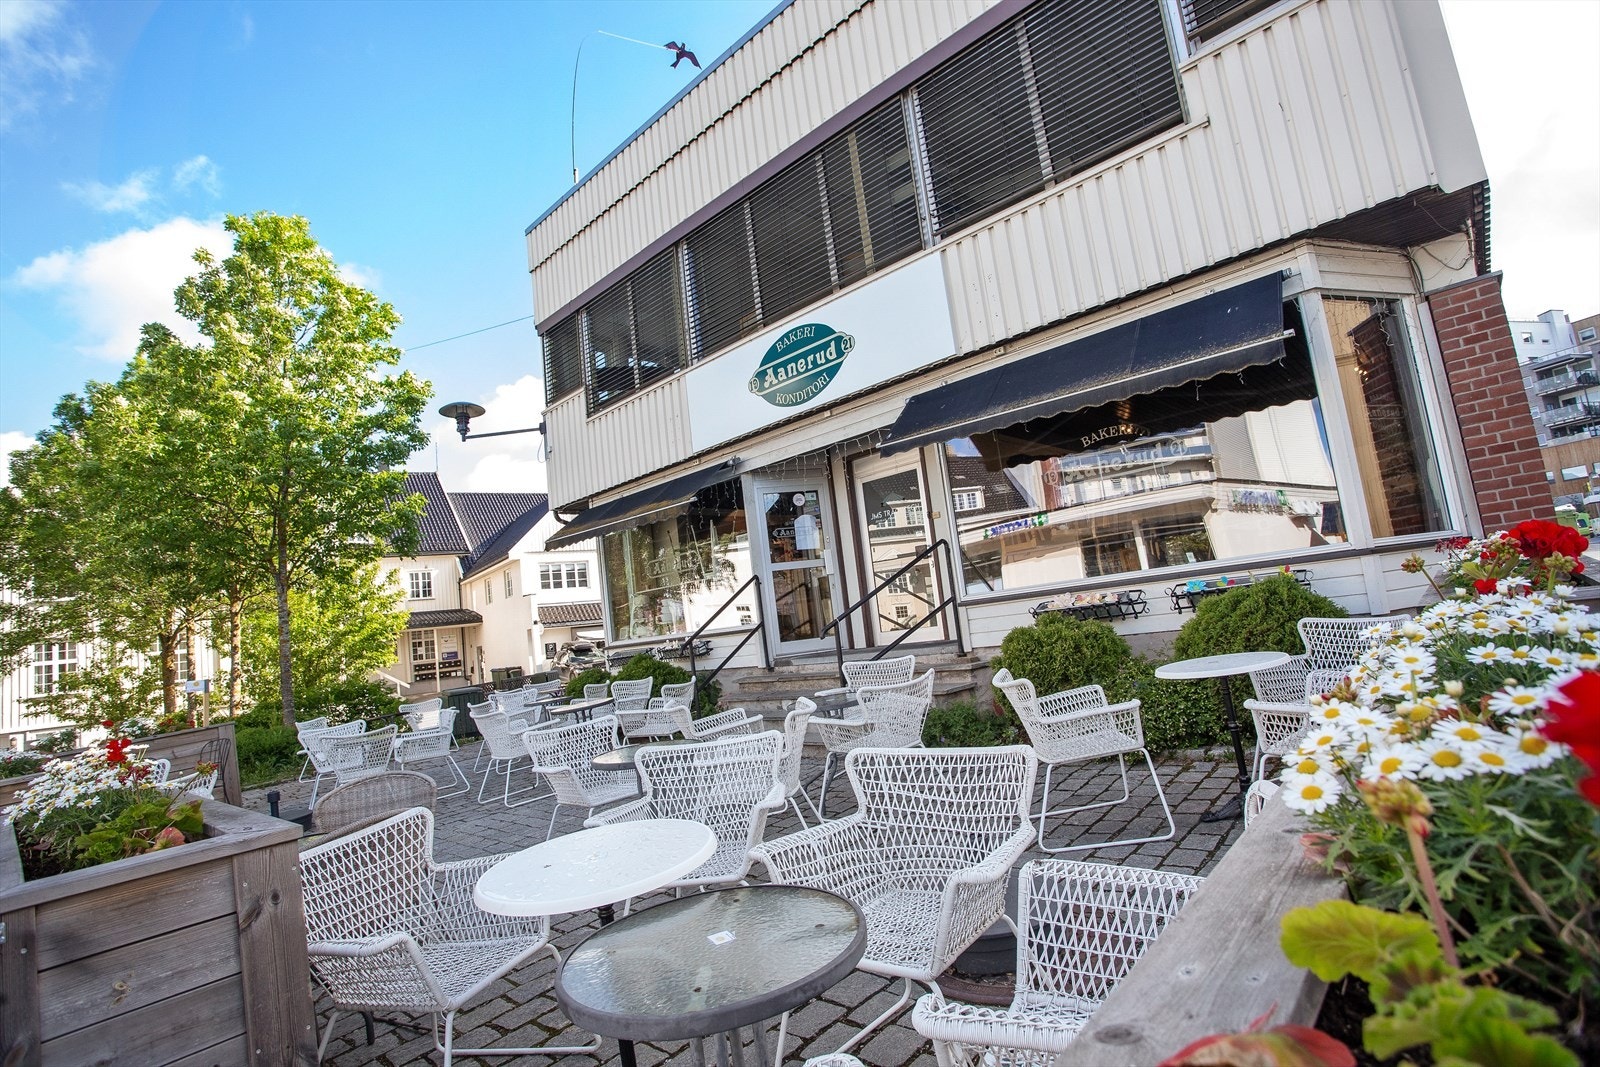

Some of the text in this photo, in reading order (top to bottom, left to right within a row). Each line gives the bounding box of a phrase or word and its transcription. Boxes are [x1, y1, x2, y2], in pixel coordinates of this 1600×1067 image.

[775, 325, 816, 353] BAKERI
[763, 340, 837, 388] Aanerud
[842, 336, 853, 350] 21
[775, 372, 830, 405] KONDITORI
[1080, 423, 1135, 448] BAKERI
